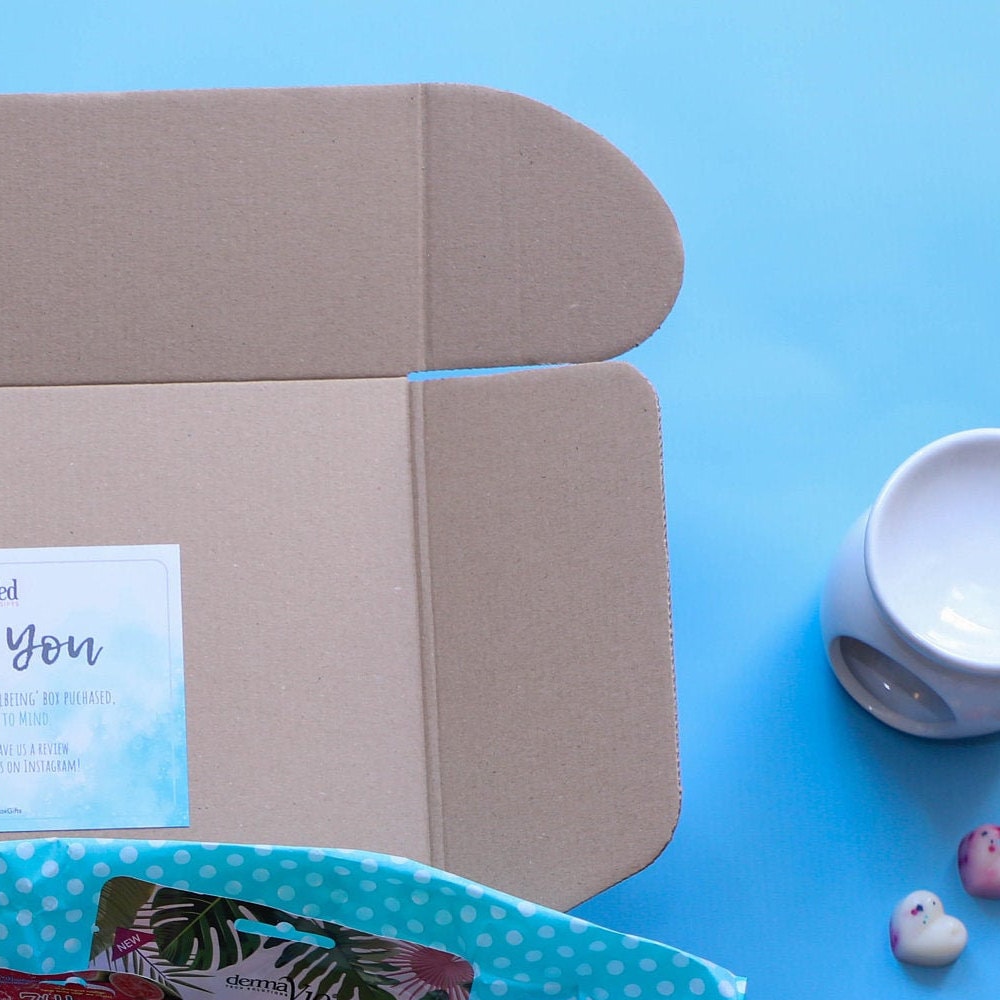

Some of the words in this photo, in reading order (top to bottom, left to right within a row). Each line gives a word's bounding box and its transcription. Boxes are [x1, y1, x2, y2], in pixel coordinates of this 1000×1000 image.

[6, 623, 104, 671] You
[43, 690, 60, 706] BOX
[3, 710, 15, 727] TO
[17, 742, 27, 757] US
[30, 743, 36, 756] A
[38, 741, 70, 756] REVIEW
[7, 759, 21, 773] ON
[23, 758, 81, 773] INSTAGRAM!
[116, 934, 141, 953] NEW
